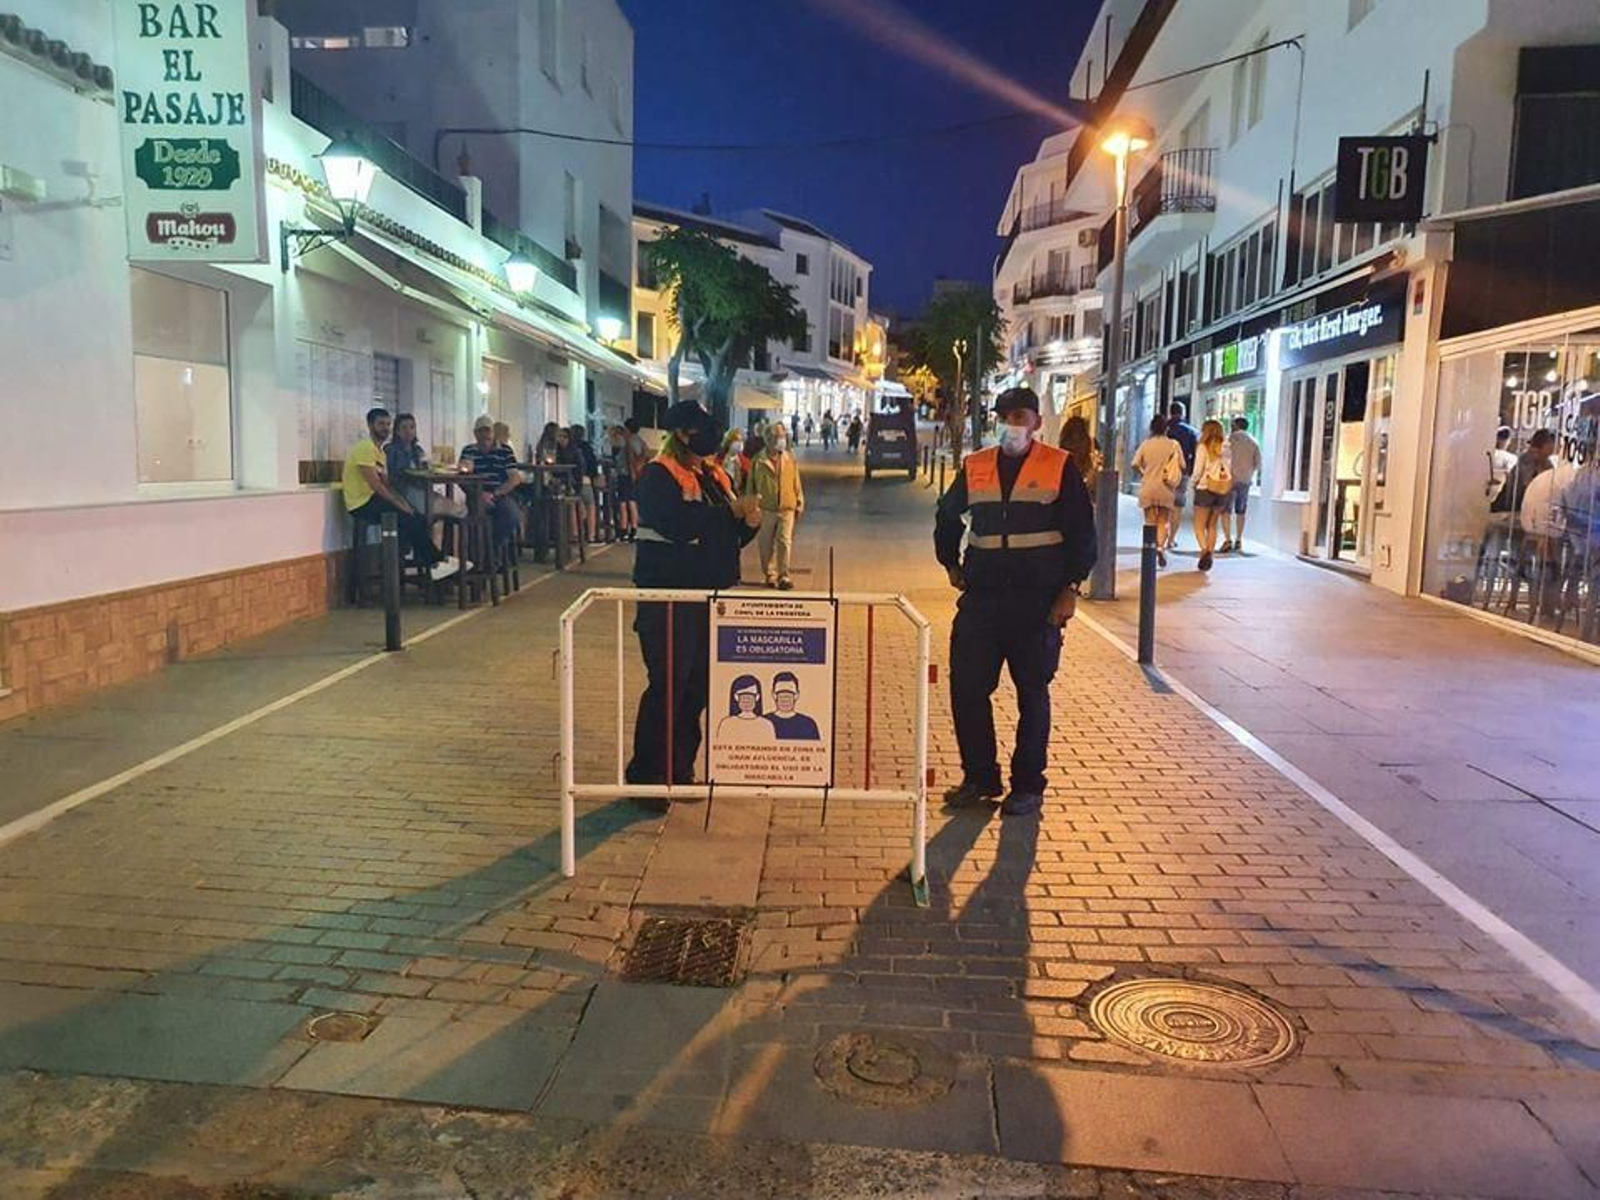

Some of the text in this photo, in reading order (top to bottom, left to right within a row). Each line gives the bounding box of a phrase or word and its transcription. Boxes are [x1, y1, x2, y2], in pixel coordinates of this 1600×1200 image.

[138, 3, 222, 39] BAR
[162, 49, 202, 81] EL
[122, 91, 245, 126] PASAJE
[153, 140, 222, 164] Desde
[1357, 146, 1409, 200] TGB
[157, 219, 227, 237] Mahou
[735, 645, 804, 655] ES OBLIGATORIA
[737, 635, 803, 645] LA MASCARILLA
